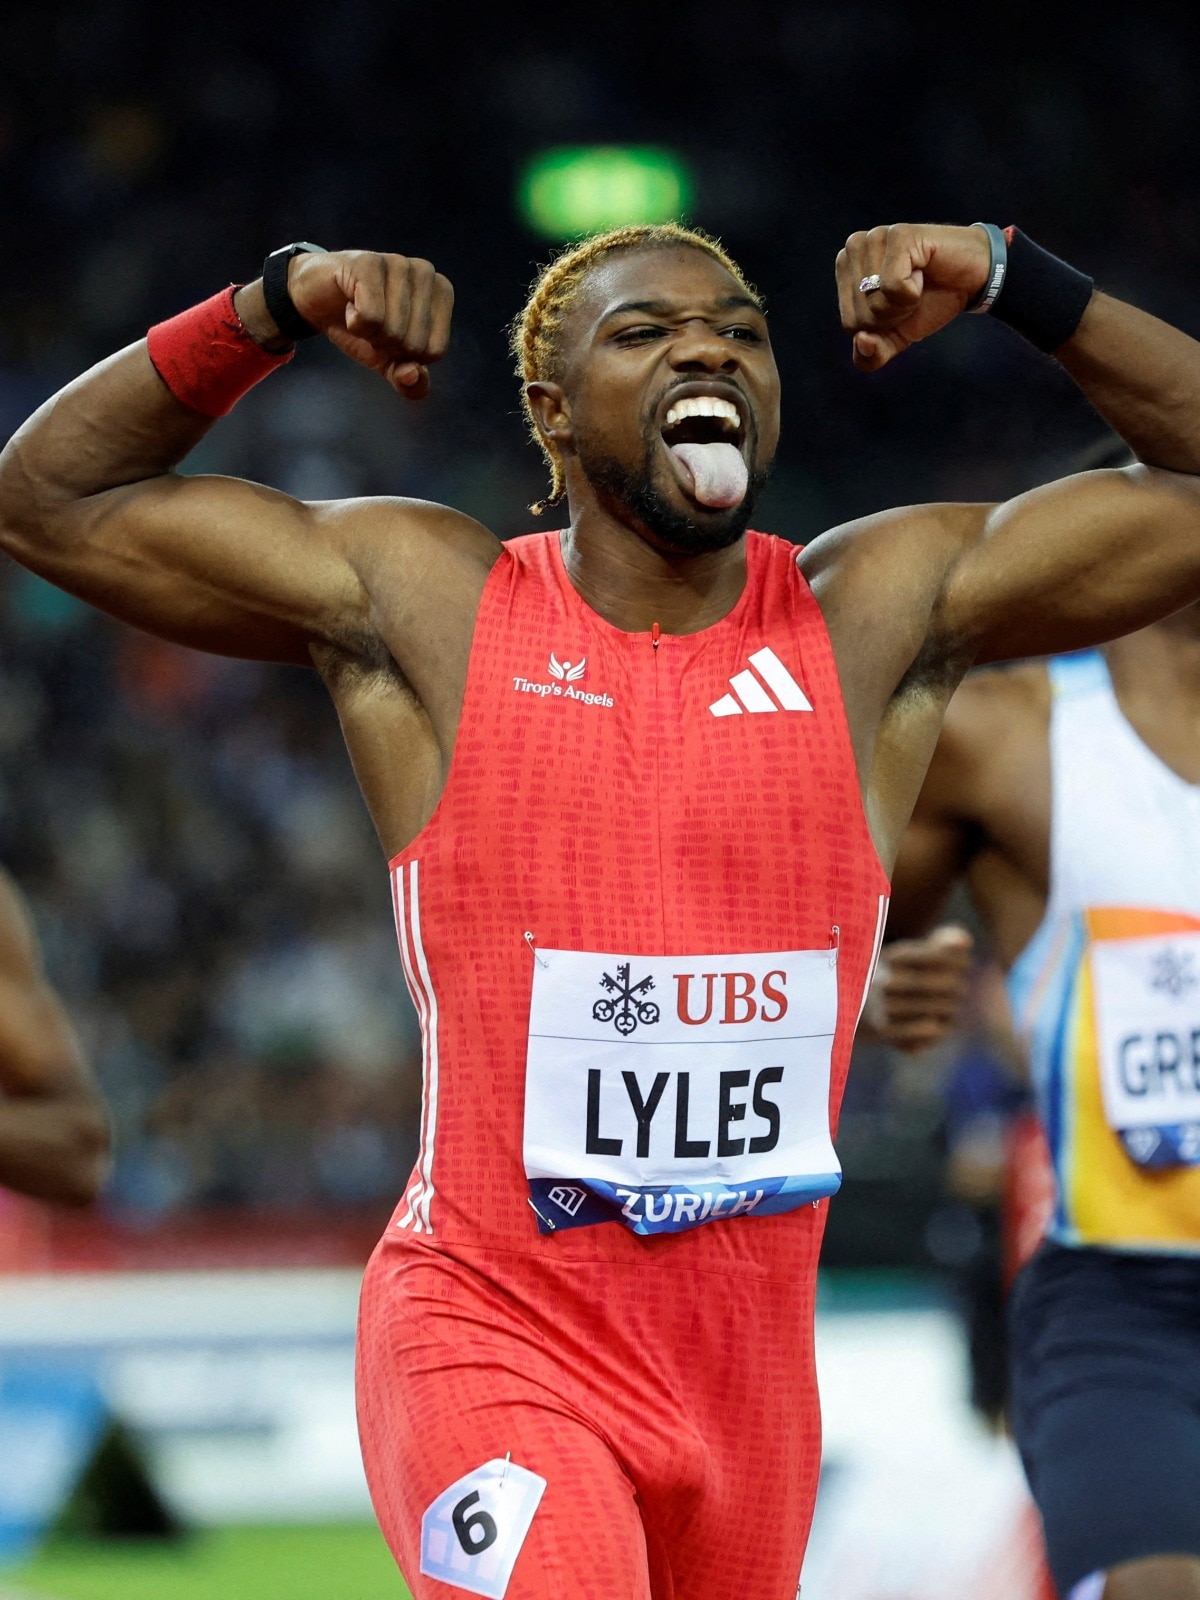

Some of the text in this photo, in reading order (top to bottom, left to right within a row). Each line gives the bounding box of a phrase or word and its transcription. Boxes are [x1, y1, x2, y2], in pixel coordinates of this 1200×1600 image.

[990, 263, 1005, 288] Things
[512, 677, 615, 708] Tirop's Angels
[672, 970, 789, 1026] UBS
[585, 1066, 785, 1158] LYLES
[615, 1188, 764, 1223] ZURICH
[451, 1489, 498, 1556] 6
